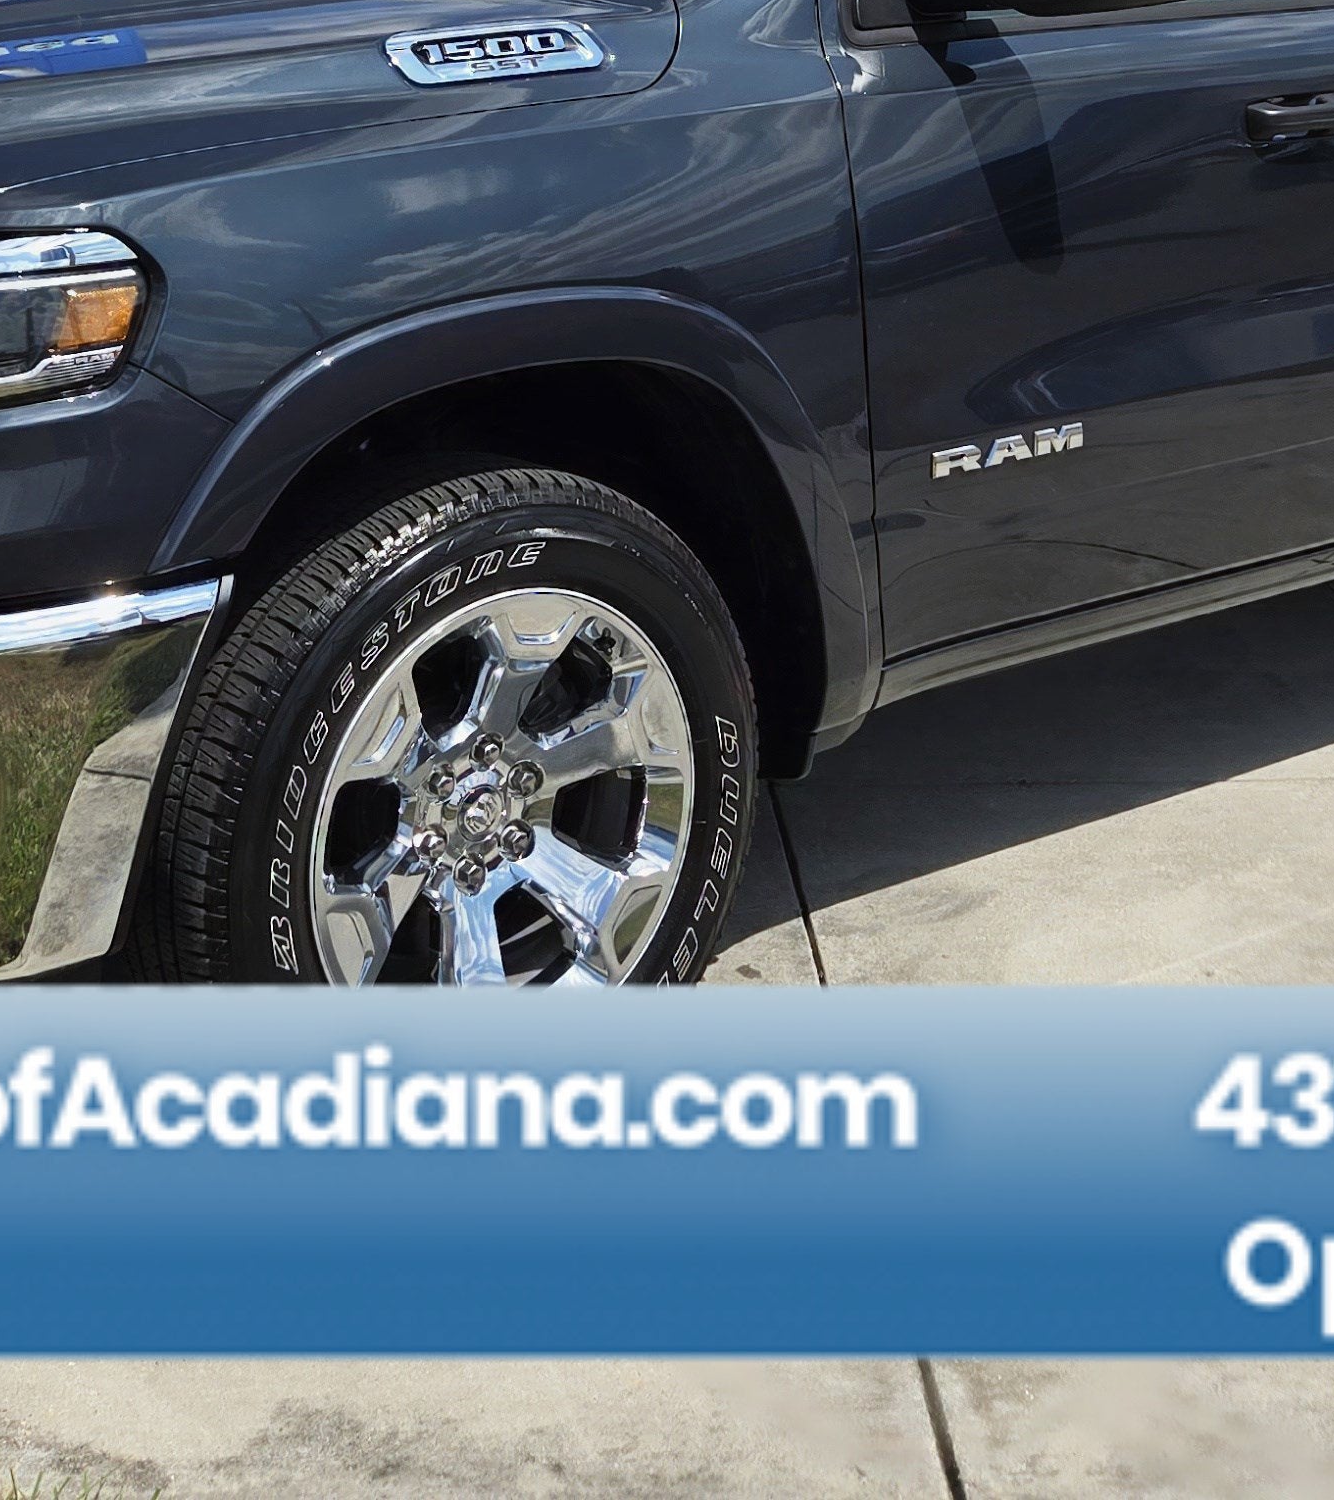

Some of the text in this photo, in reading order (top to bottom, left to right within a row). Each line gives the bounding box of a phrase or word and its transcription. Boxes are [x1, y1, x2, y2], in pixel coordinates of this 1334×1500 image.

[420, 32, 566, 65] 1500
[931, 422, 1084, 480] RAM
[269, 540, 547, 975] BRIDGESTONE
[657, 715, 741, 988] DUELE
